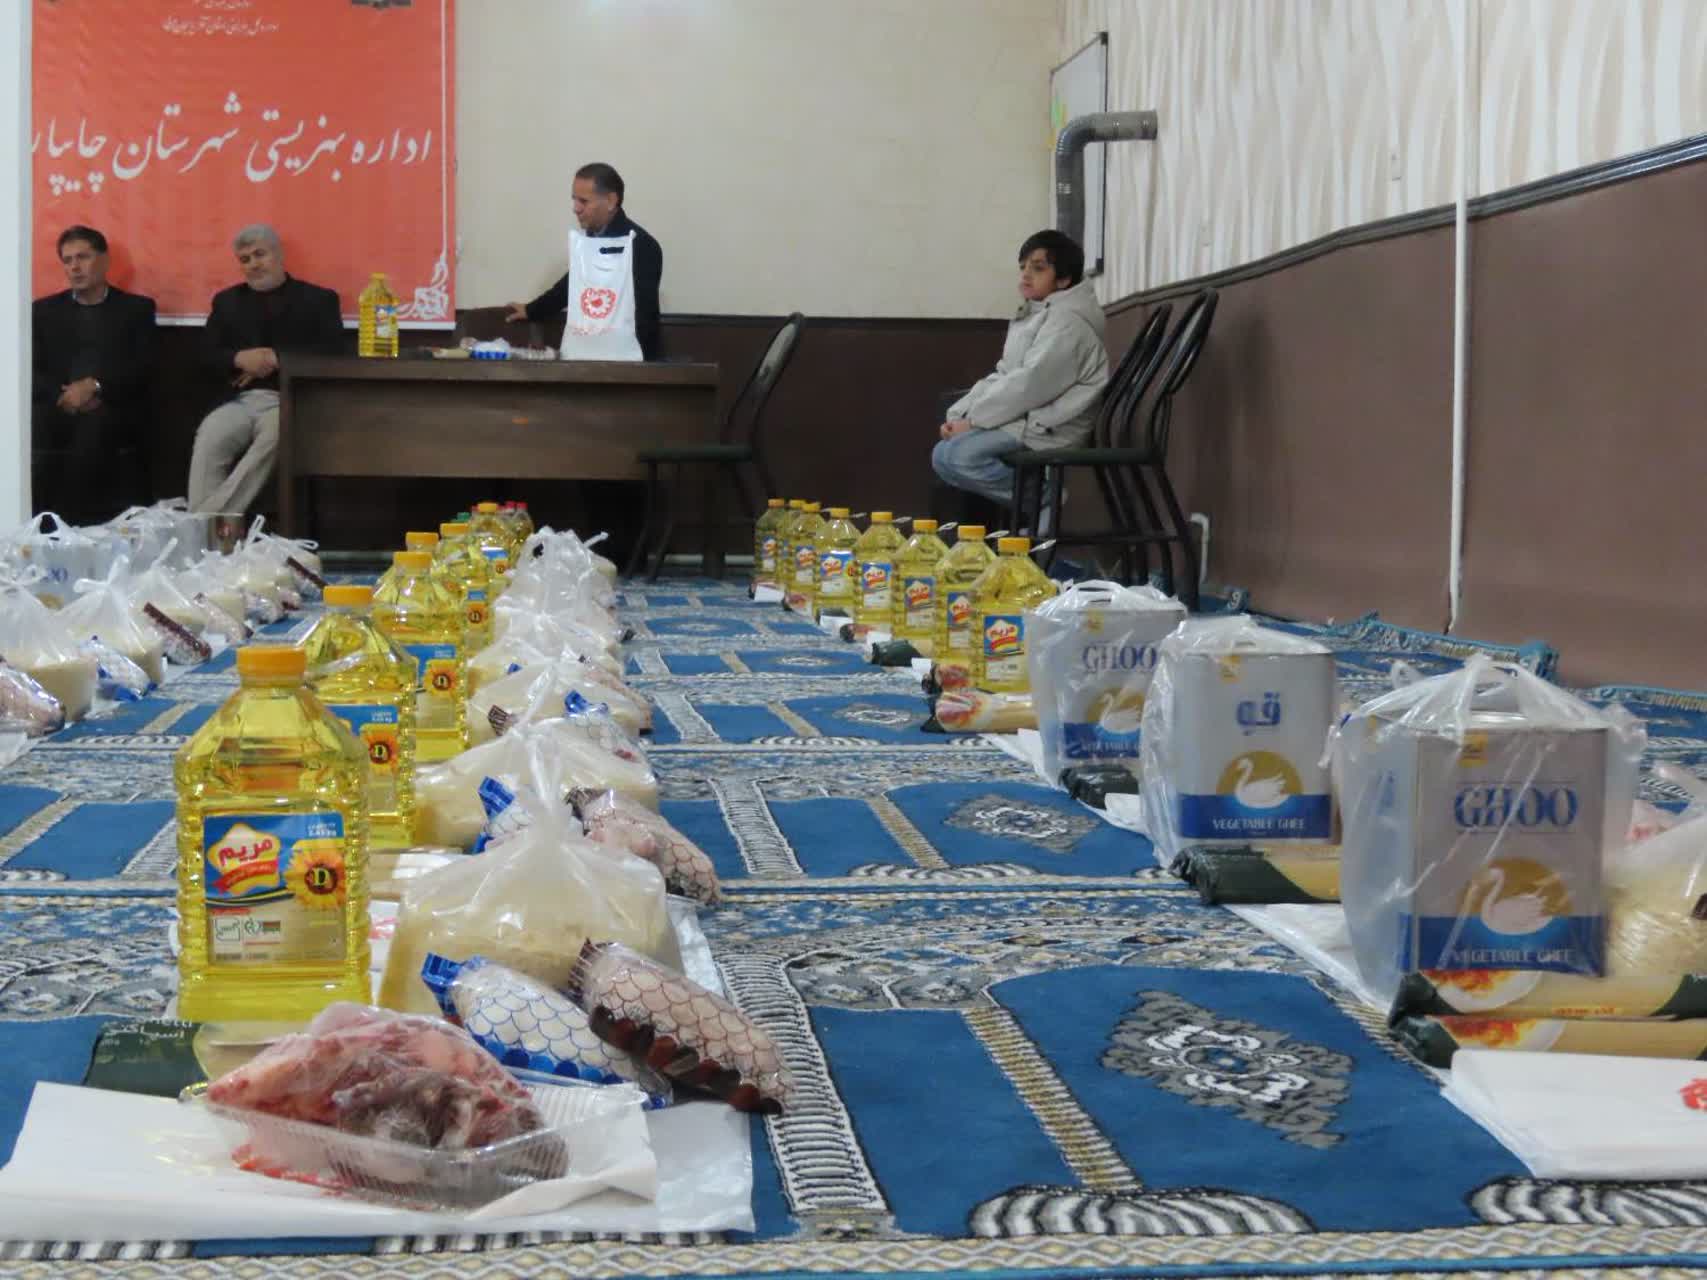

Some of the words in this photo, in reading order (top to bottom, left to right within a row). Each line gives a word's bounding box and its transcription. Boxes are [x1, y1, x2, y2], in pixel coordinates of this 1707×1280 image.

[111, 91, 241, 181] شهرستان
[245, 108, 346, 183] بهزیستی
[350, 128, 432, 165] اداره
[1082, 646, 1157, 673] GHOO
[1454, 787, 1578, 828] GHOO
[1212, 817, 1275, 830] VEGETABLE
[1277, 817, 1305, 830] GHEE
[218, 838, 274, 867] مریم
[313, 867, 331, 886] D
[1453, 948, 1530, 964] VEGETABLE
[1537, 948, 1574, 964] GHEE
